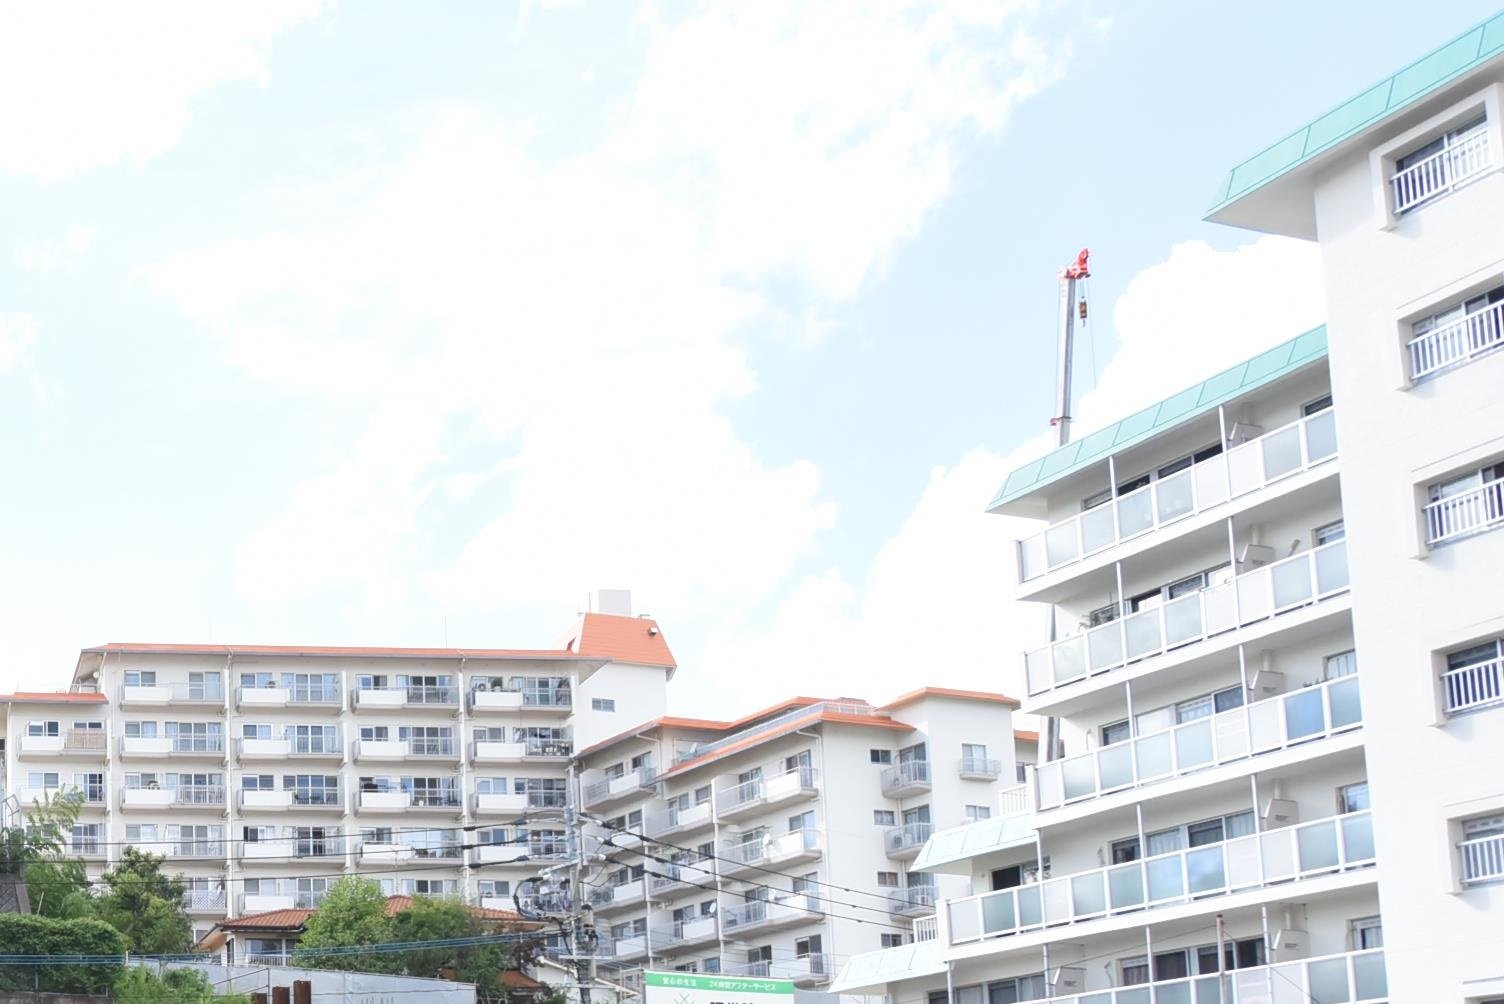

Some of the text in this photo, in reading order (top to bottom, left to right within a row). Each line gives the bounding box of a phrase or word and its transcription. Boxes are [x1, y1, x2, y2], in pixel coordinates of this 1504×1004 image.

[709, 980, 777, 992] 24時間アフターサービス
